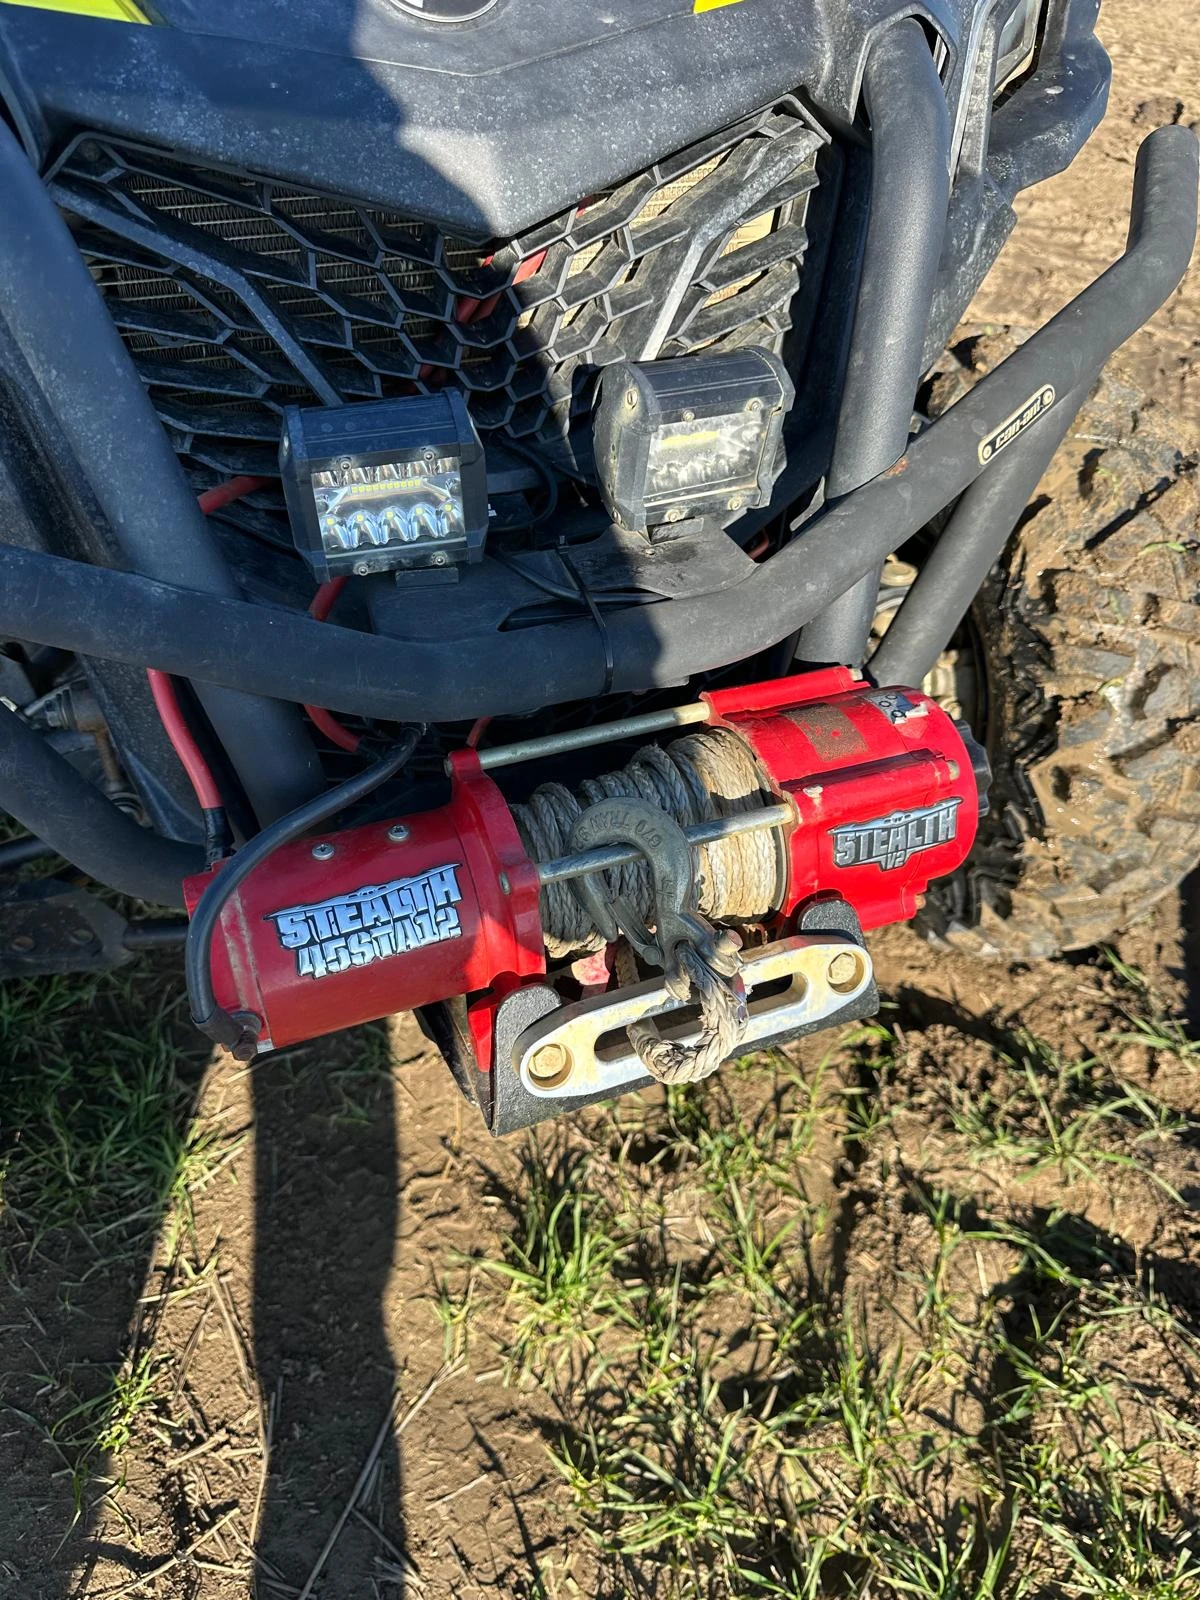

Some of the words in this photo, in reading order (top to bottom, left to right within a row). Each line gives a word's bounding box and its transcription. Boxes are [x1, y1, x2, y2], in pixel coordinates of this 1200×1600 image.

[835, 802, 958, 865] STEALTH
[886, 850, 906, 870] V2
[276, 867, 462, 949] STEALTH
[297, 906, 463, 979] 45STA12
